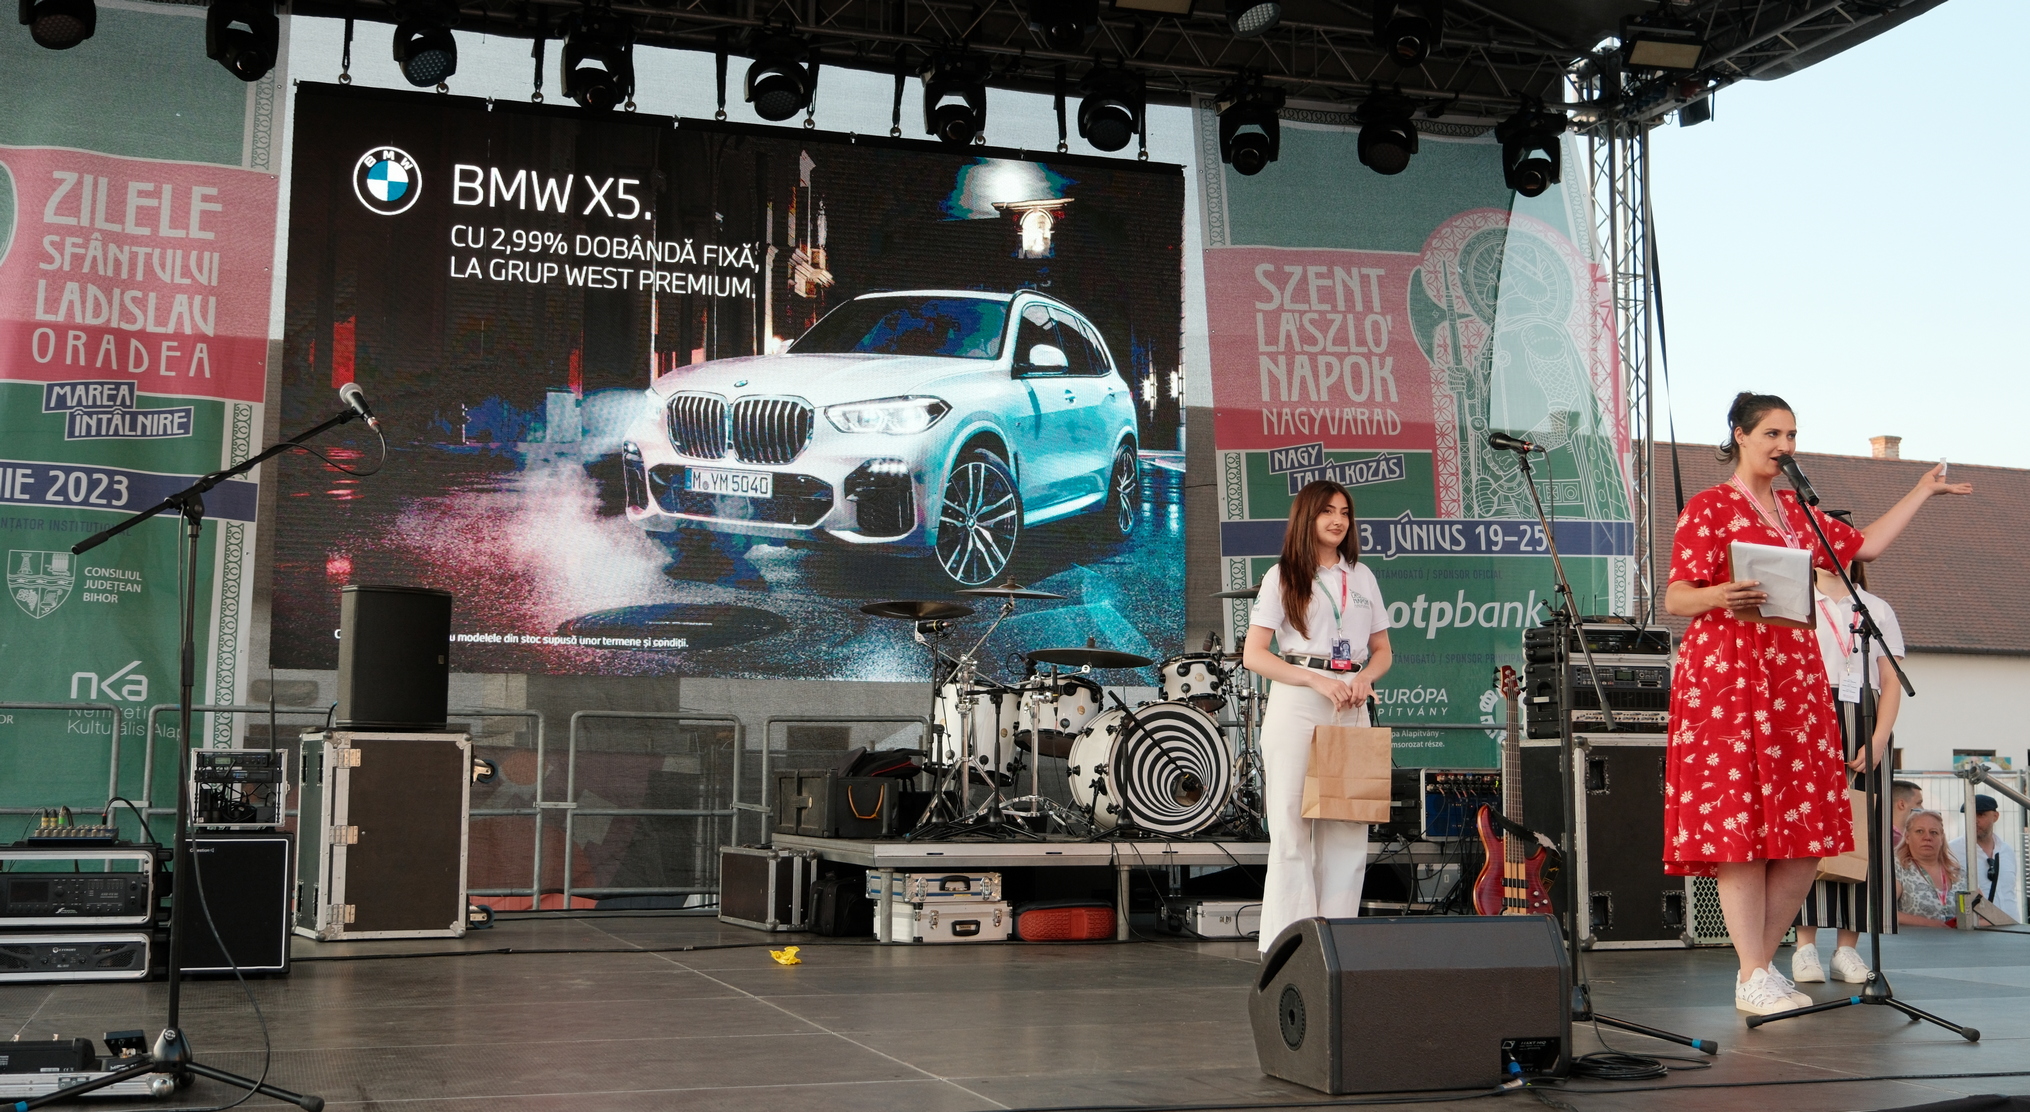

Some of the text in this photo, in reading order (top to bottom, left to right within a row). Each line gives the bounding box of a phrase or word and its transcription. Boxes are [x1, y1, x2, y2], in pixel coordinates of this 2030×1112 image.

[363, 150, 414, 171] BMW
[43, 170, 222, 240] ZILELE
[453, 164, 652, 220] BMW X5.
[39, 233, 220, 286] SFÂNTULUI
[451, 225, 760, 274] CU 2,99% DOBÂNDĂ FIXĂ,
[450, 257, 756, 299] LA GRUP WEST PREMIUM.
[1254, 264, 1385, 311] SZENT
[32, 327, 211, 378] ORADEA
[1258, 355, 1399, 402] NAPOK
[50, 384, 132, 407] MAREA
[74, 409, 187, 436] ÎNTÂLNIRE
[1274, 445, 1319, 470] NAGY
[45, 470, 129, 506] 2023
[693, 471, 768, 494] M YM 5040
[1387, 517, 1466, 556] JÚNIUS
[84, 567, 142, 581] CONSILIUL
[84, 580, 142, 593] JUDEȚEAN
[1433, 570, 1470, 580] SPONSOR
[1473, 570, 1503, 580] OFICIAL
[83, 592, 118, 604] BIHOR
[1389, 589, 1543, 639] otpbank
[458, 633, 502, 643] modelele
[504, 634, 518, 643] din
[521, 635, 541, 644] stoc
[579, 636, 601, 646] unor
[602, 637, 641, 647] termene
[1446, 654, 1482, 664] SPONSOR
[69, 706, 147, 719] Nemeti
[67, 720, 145, 736] Kultuális
